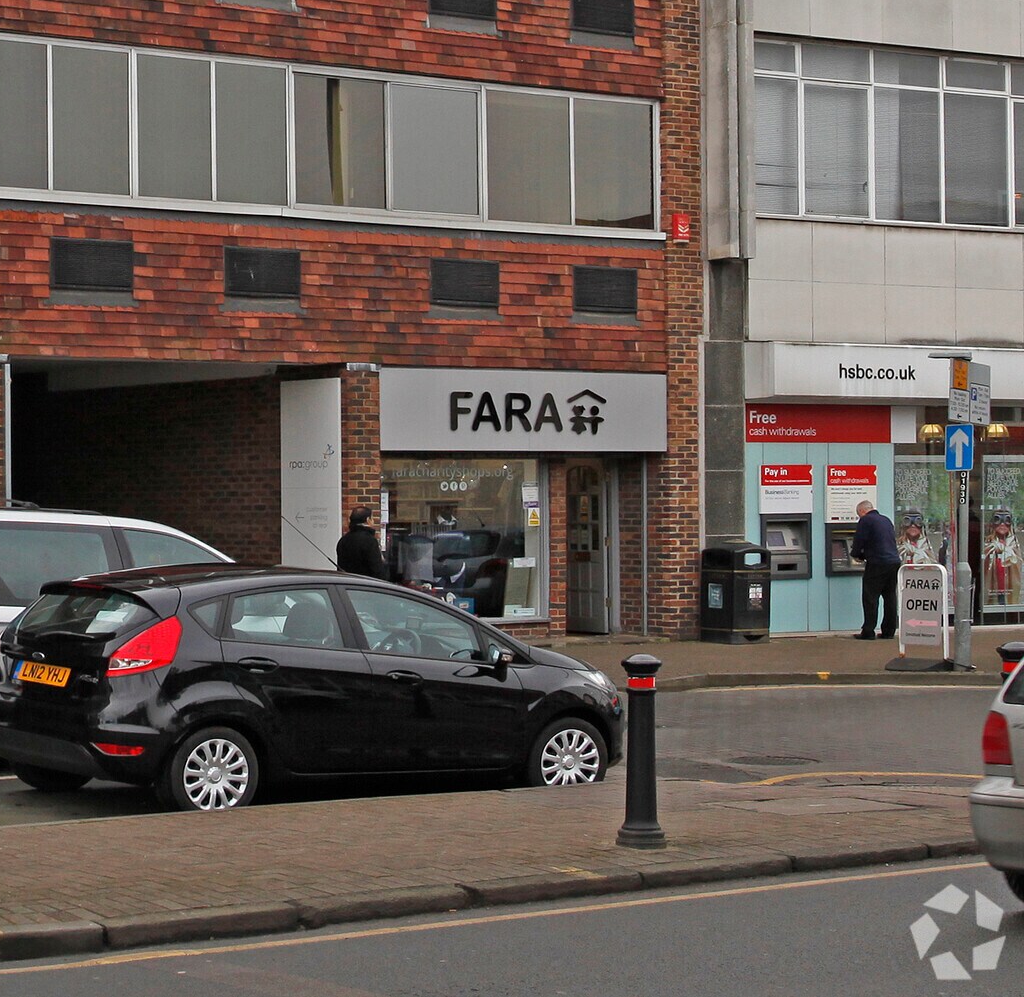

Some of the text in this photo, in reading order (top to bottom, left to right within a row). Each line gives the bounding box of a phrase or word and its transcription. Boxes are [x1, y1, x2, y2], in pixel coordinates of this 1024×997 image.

[839, 363, 916, 381] hsbc.co.uk
[450, 391, 563, 432] FARA
[749, 410, 777, 424] Free
[749, 427, 817, 436] cash withdrawals
[392, 466, 514, 481] faracharityshops.org
[764, 467, 788, 477] Pay in
[830, 468, 847, 476] Free
[959, 471, 967, 504] 01930
[905, 578, 930, 590] FARA
[906, 599, 938, 611] OPEN
[21, 663, 46, 679] LN12
[46, 667, 67, 683] YHJ
